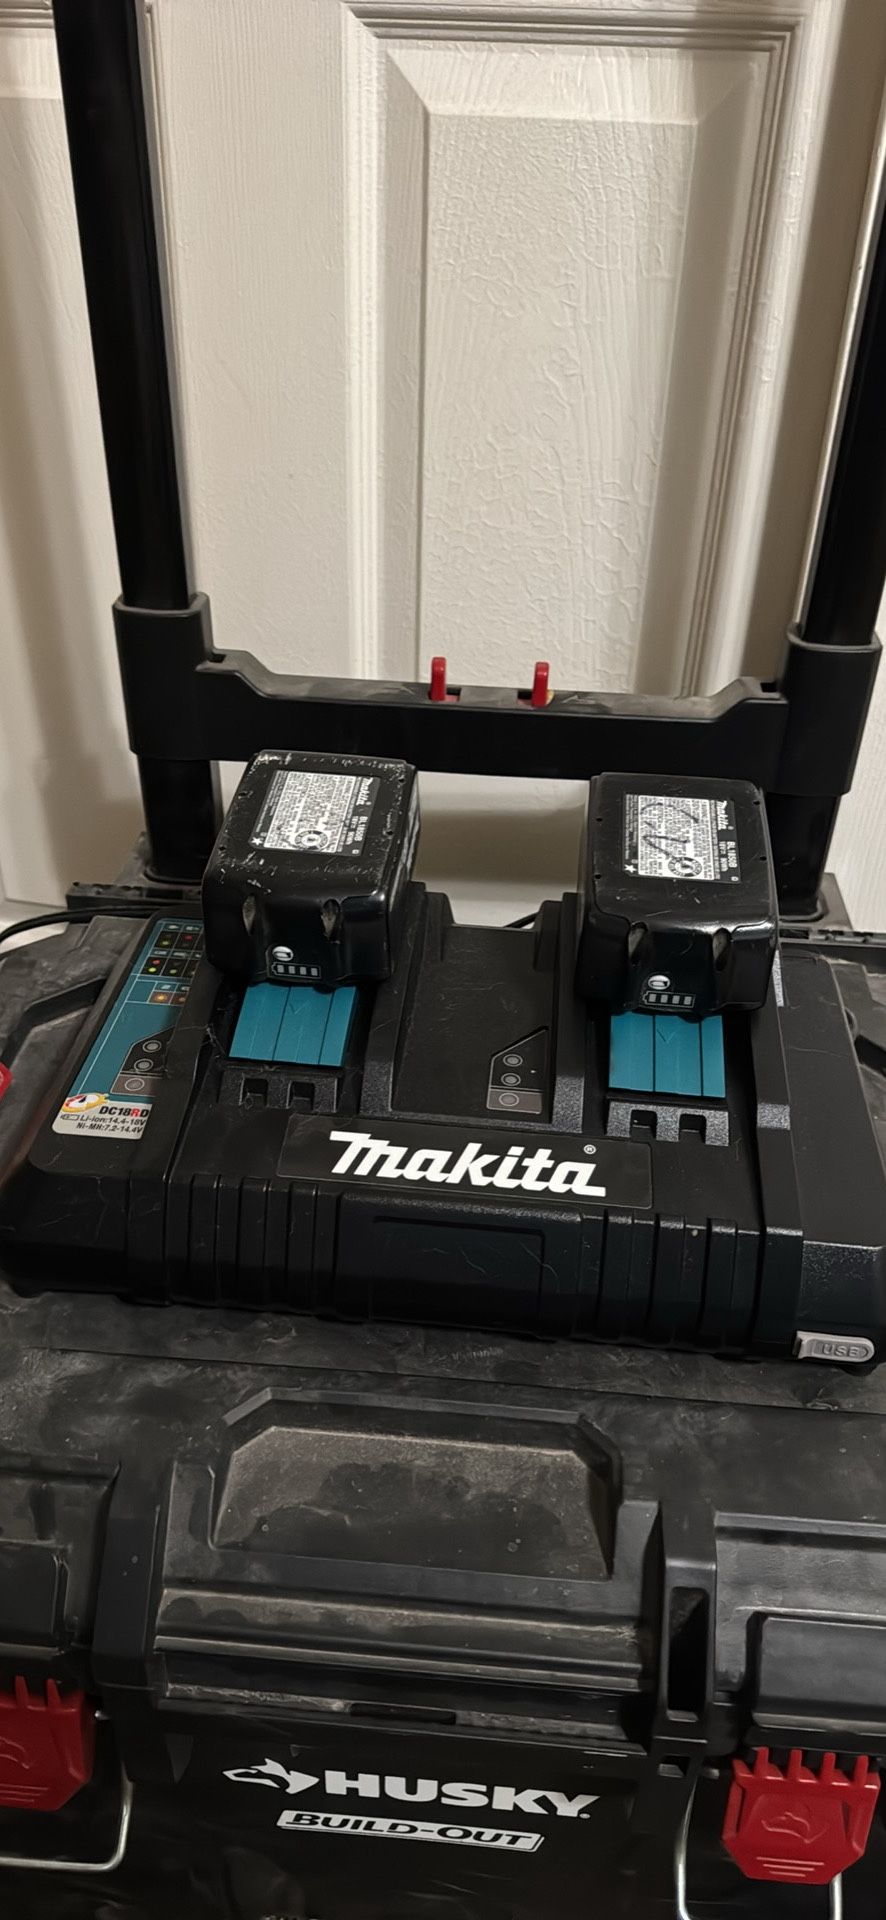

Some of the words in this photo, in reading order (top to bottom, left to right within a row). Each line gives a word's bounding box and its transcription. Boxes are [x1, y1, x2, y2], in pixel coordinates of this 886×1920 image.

[354, 816, 369, 842] BL1850B
[726, 841, 738, 868] BL1850B
[99, 1106, 150, 1118] DC18RD
[822, 1343, 861, 1358] USB
[325, 1770, 600, 1818] HUSKY
[287, 1812, 532, 1847] BUILD-OUT
